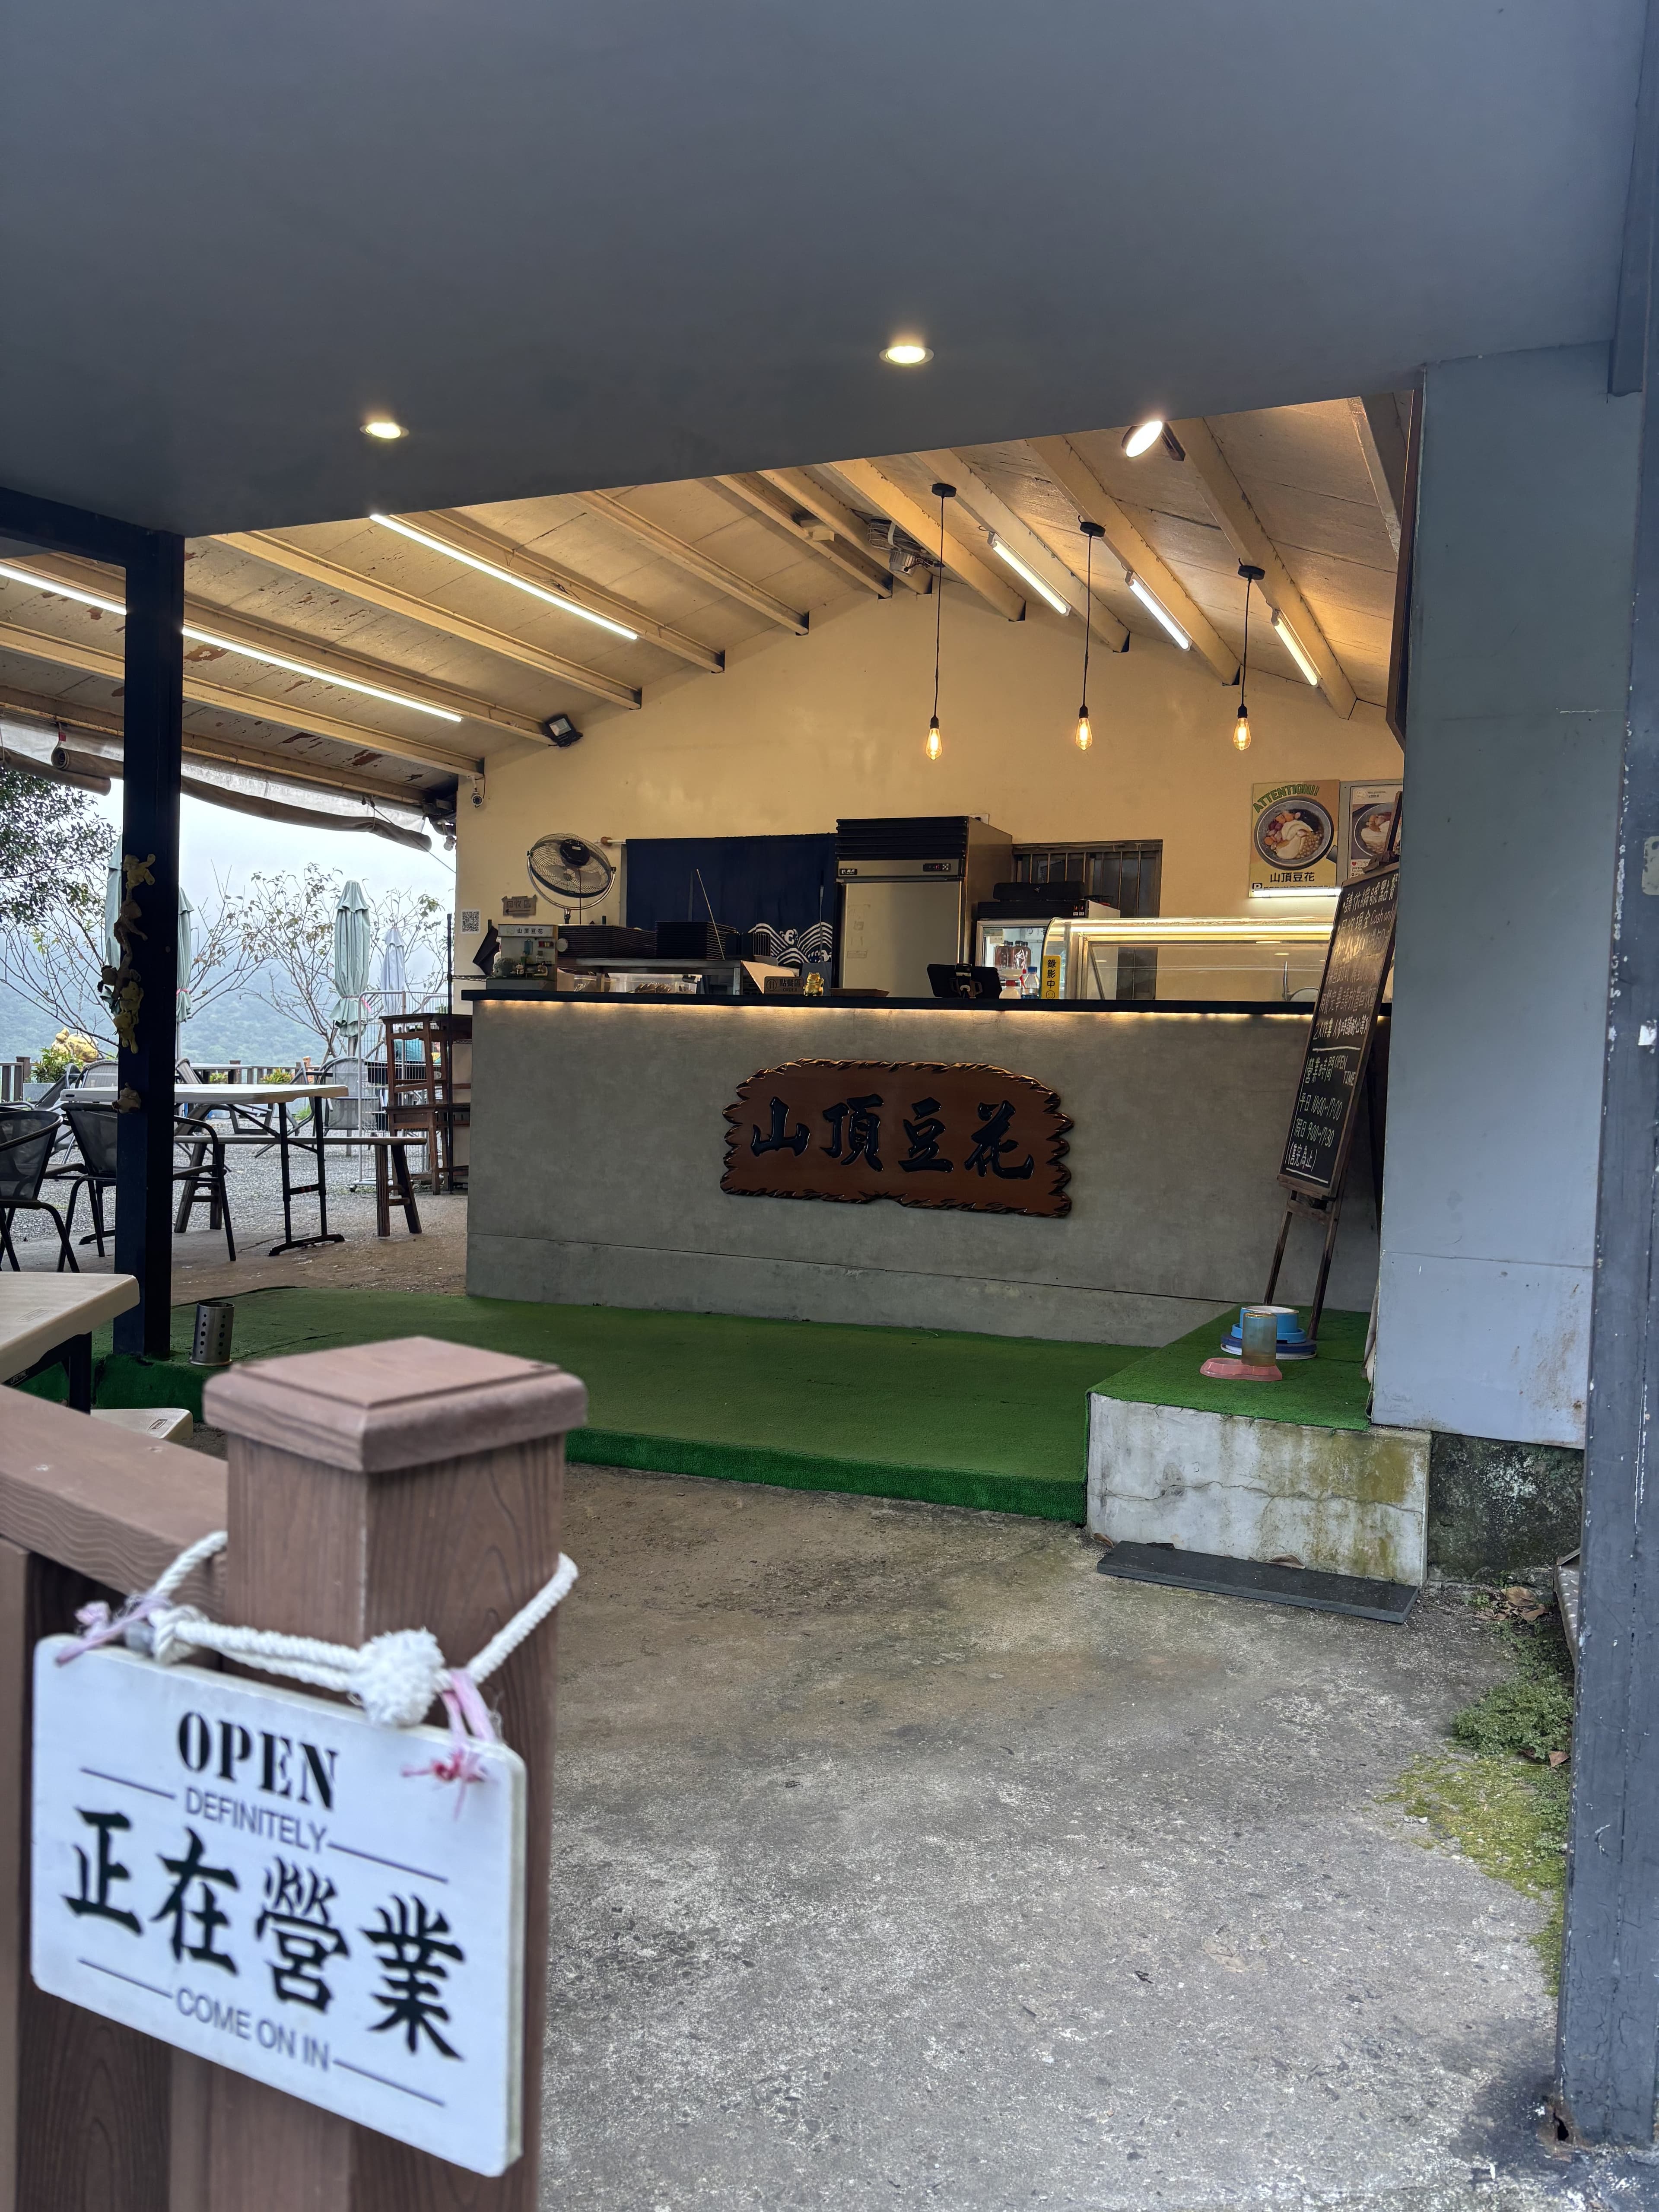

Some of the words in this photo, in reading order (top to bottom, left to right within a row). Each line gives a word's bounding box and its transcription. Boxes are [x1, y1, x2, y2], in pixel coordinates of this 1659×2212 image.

[1253, 784, 1319, 813] ATTENTION!!
[1270, 872, 1315, 883] 山頂豆花
[1047, 959, 1056, 988] 錄影中
[1305, 1056, 1335, 1084] 營業時間
[1334, 1055, 1348, 1070] OPEN
[1343, 1071, 1357, 1086] TIME
[1300, 1093, 1311, 1112] 平日
[750, 1093, 1035, 1180] 山頂豆花
[1294, 1118, 1307, 1138] 假日
[178, 1711, 338, 1812] OPEN
[186, 1786, 327, 1853] DEFINITELY
[60, 1806, 465, 2061] 正在營業
[177, 1987, 251, 2041] COME
[257, 2019, 296, 2059] ON
[304, 2034, 329, 2072] IN
